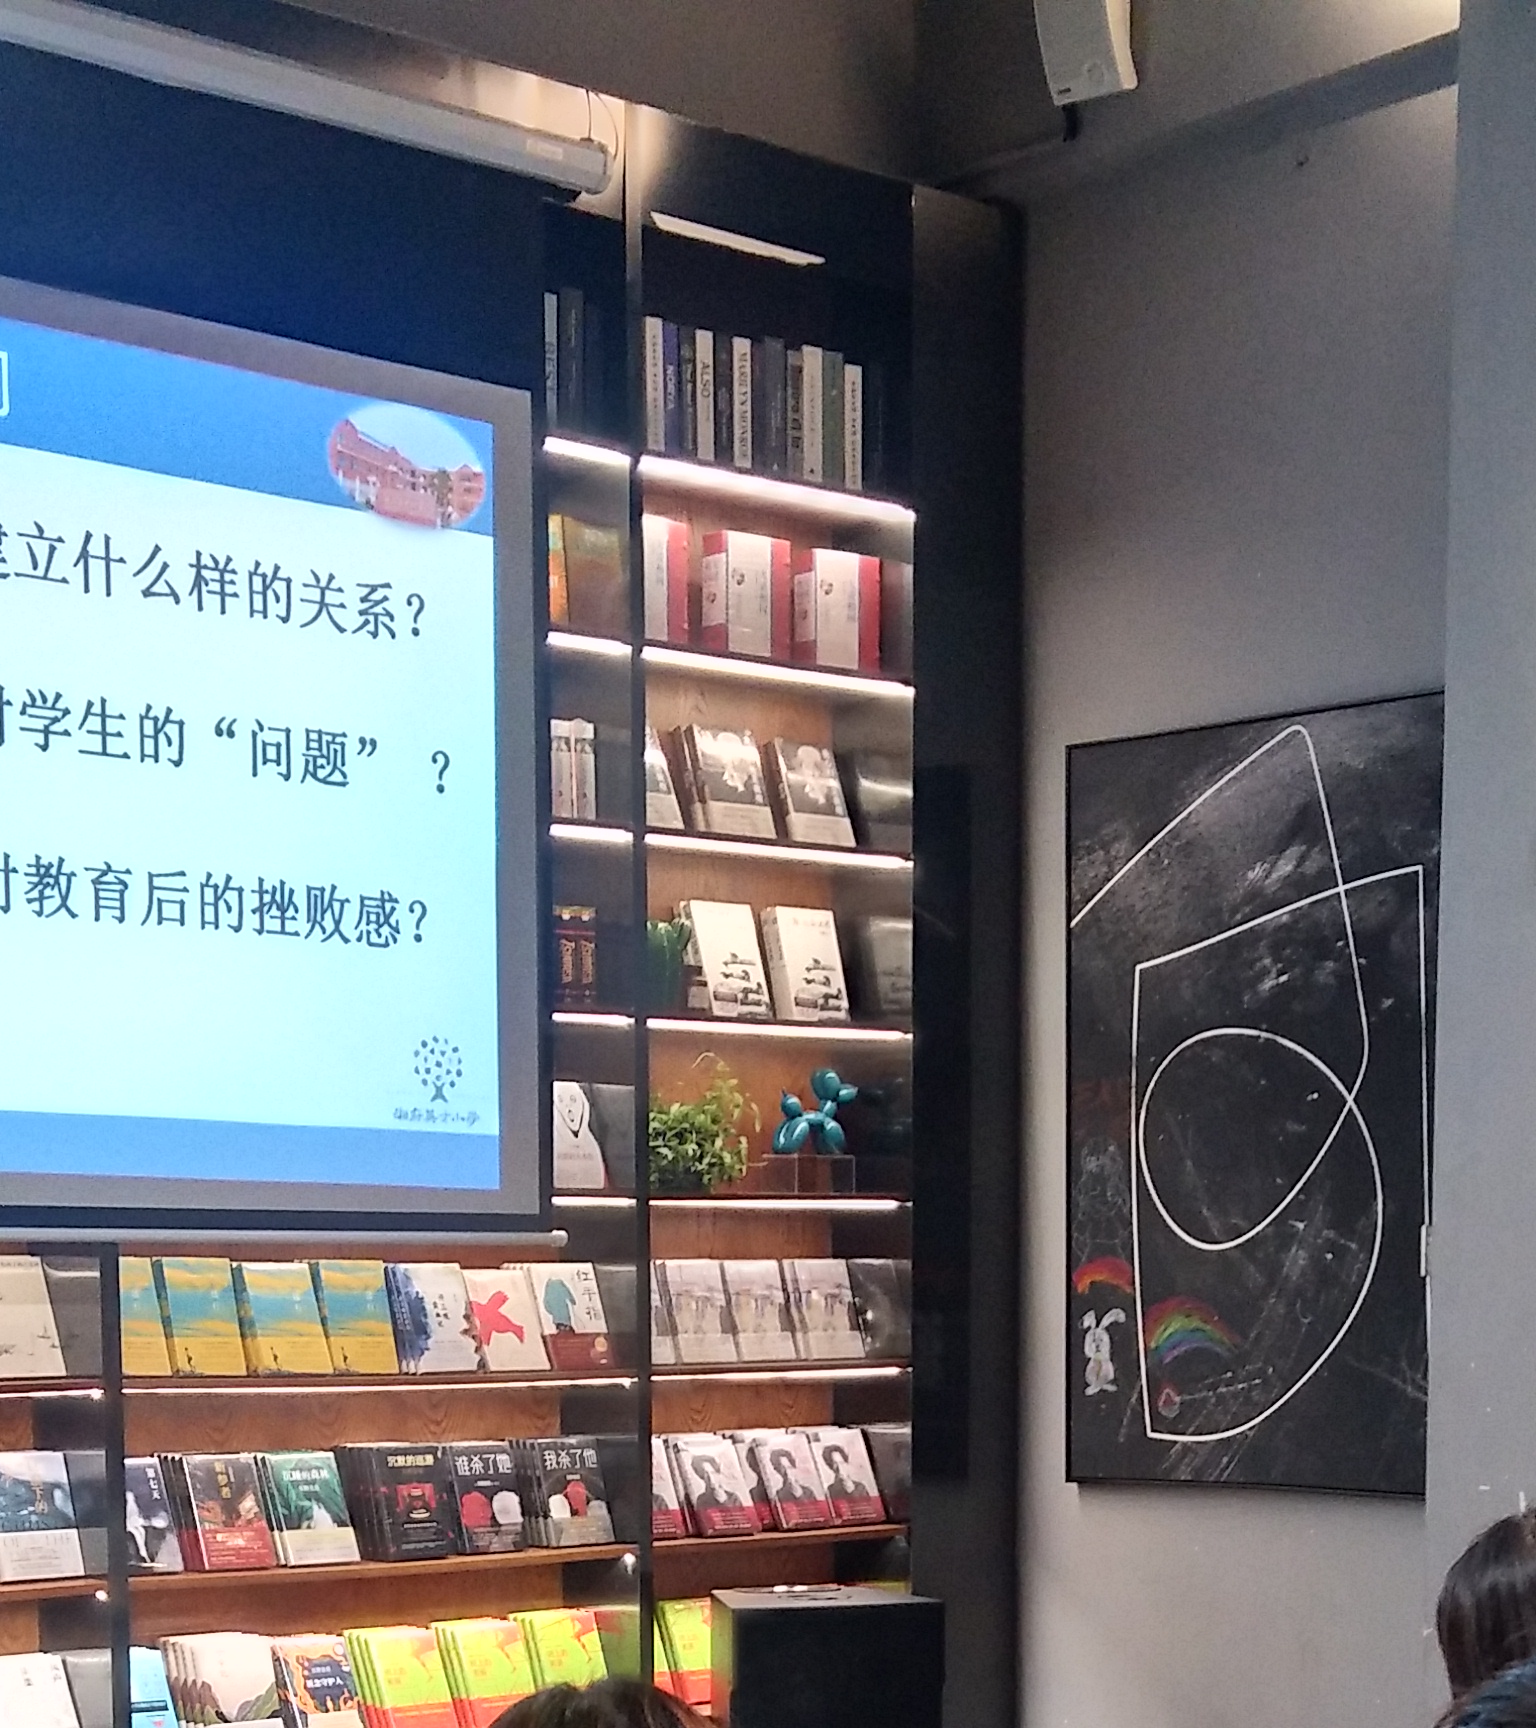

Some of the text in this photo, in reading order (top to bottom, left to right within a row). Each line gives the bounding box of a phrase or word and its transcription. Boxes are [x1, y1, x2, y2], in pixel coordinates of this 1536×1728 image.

[454, 1452, 513, 1476] 谁杀了她
[543, 1449, 598, 1471] 我杀了他
[144, 1468, 162, 1500] 第七天
